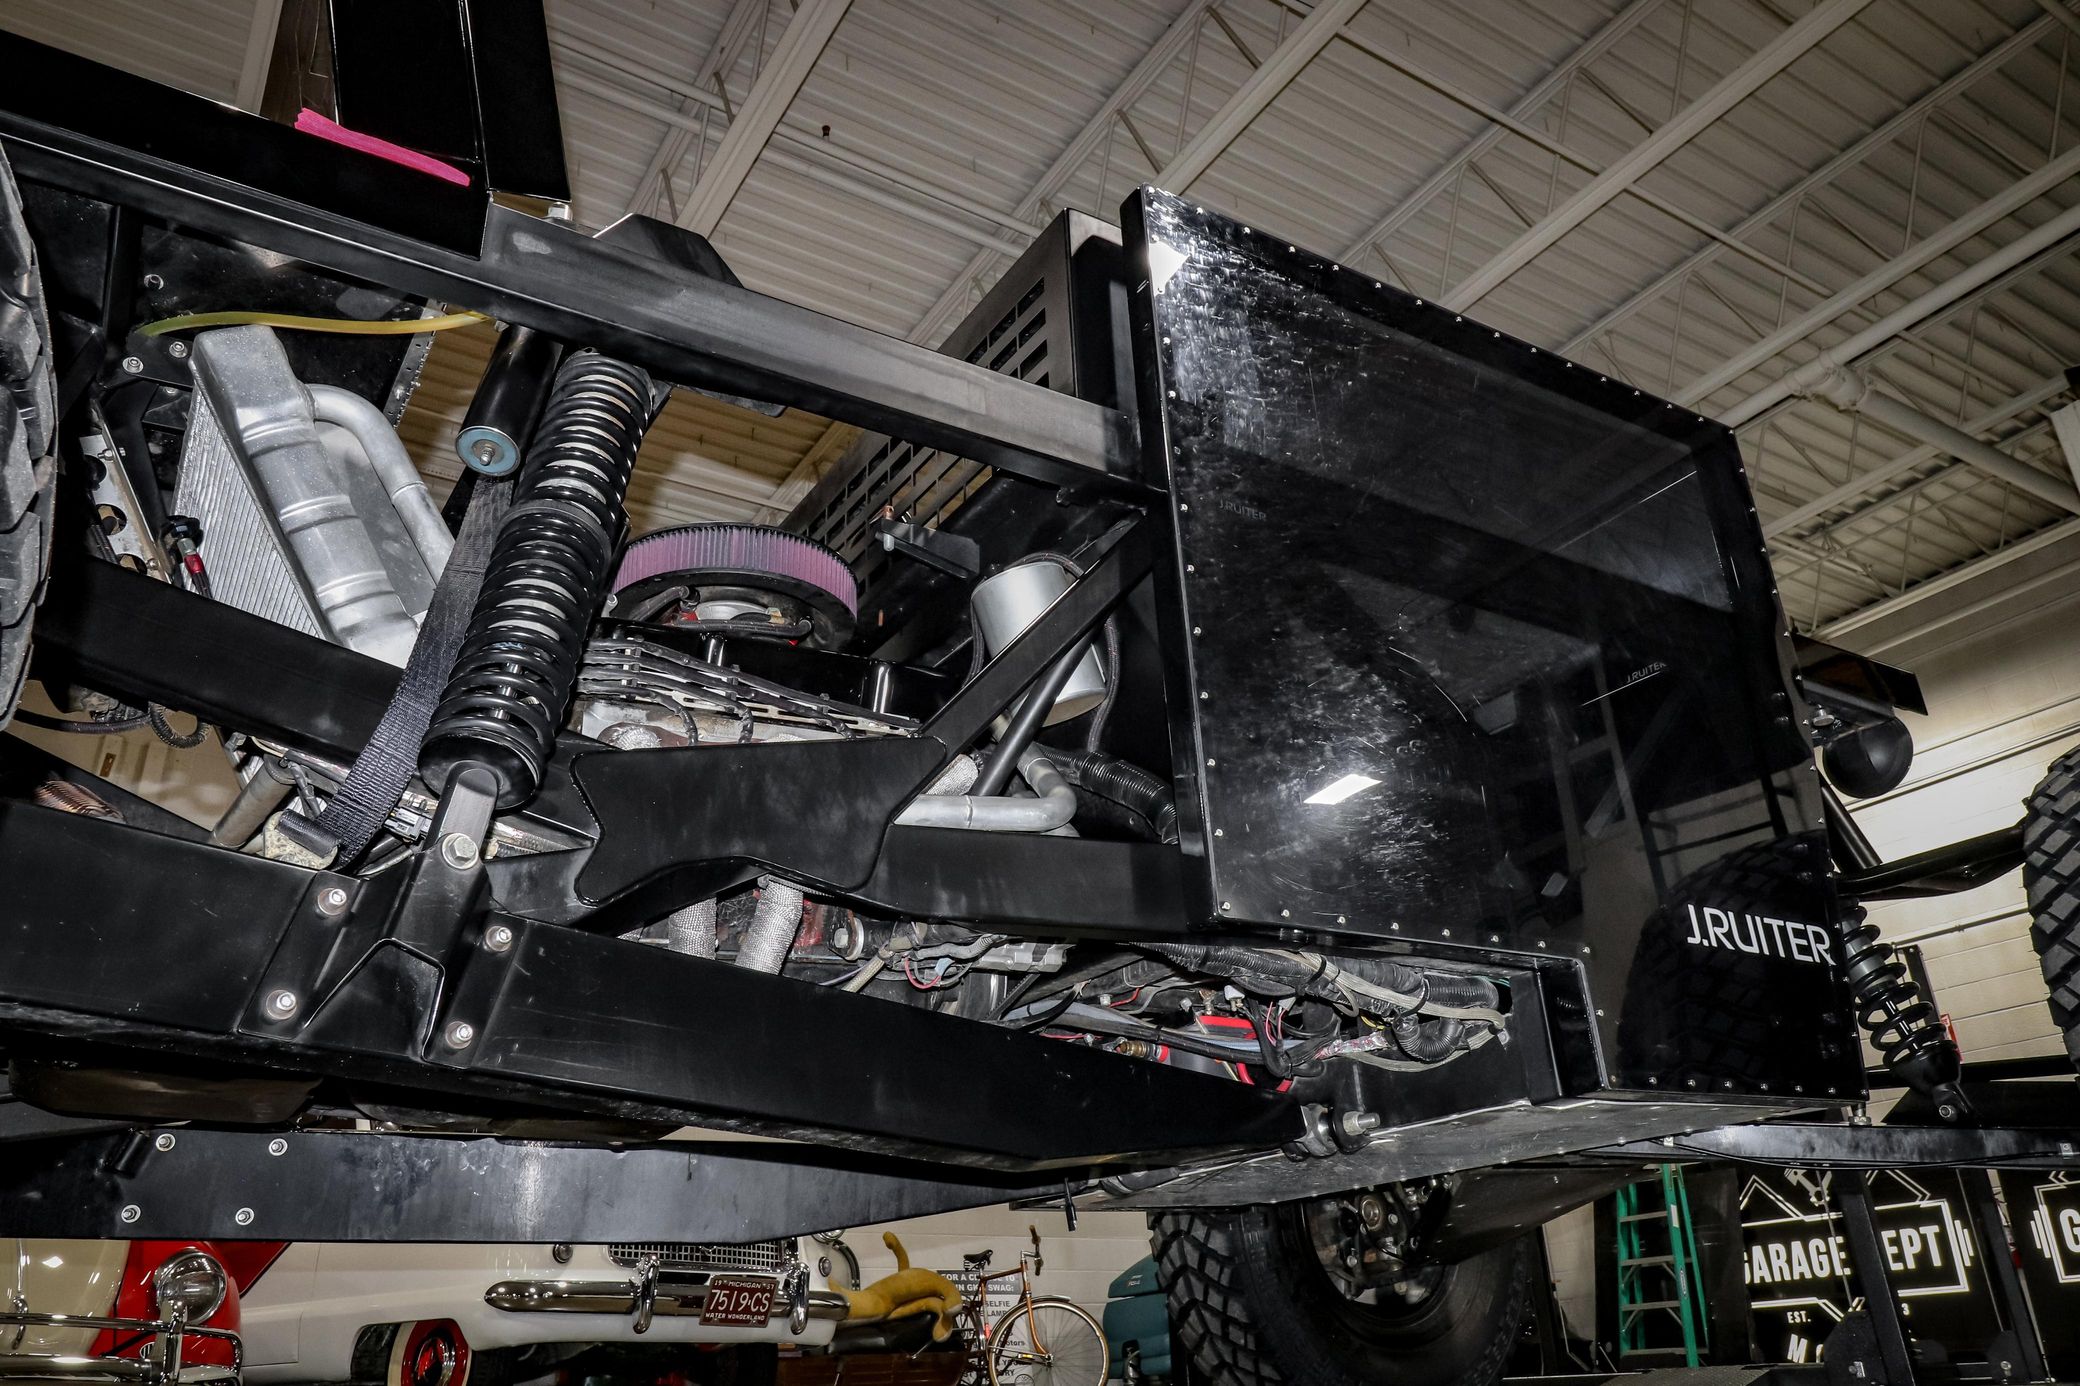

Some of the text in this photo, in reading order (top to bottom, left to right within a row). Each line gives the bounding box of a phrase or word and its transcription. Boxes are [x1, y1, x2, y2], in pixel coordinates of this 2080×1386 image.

[1687, 904, 1836, 965] J.RUITER
[1881, 1225, 1943, 1271] EPT
[728, 1281, 762, 1289] MICHIGAN
[727, 1312, 765, 1321] WONDERLAND
[1787, 1310, 1812, 1324] EST.
